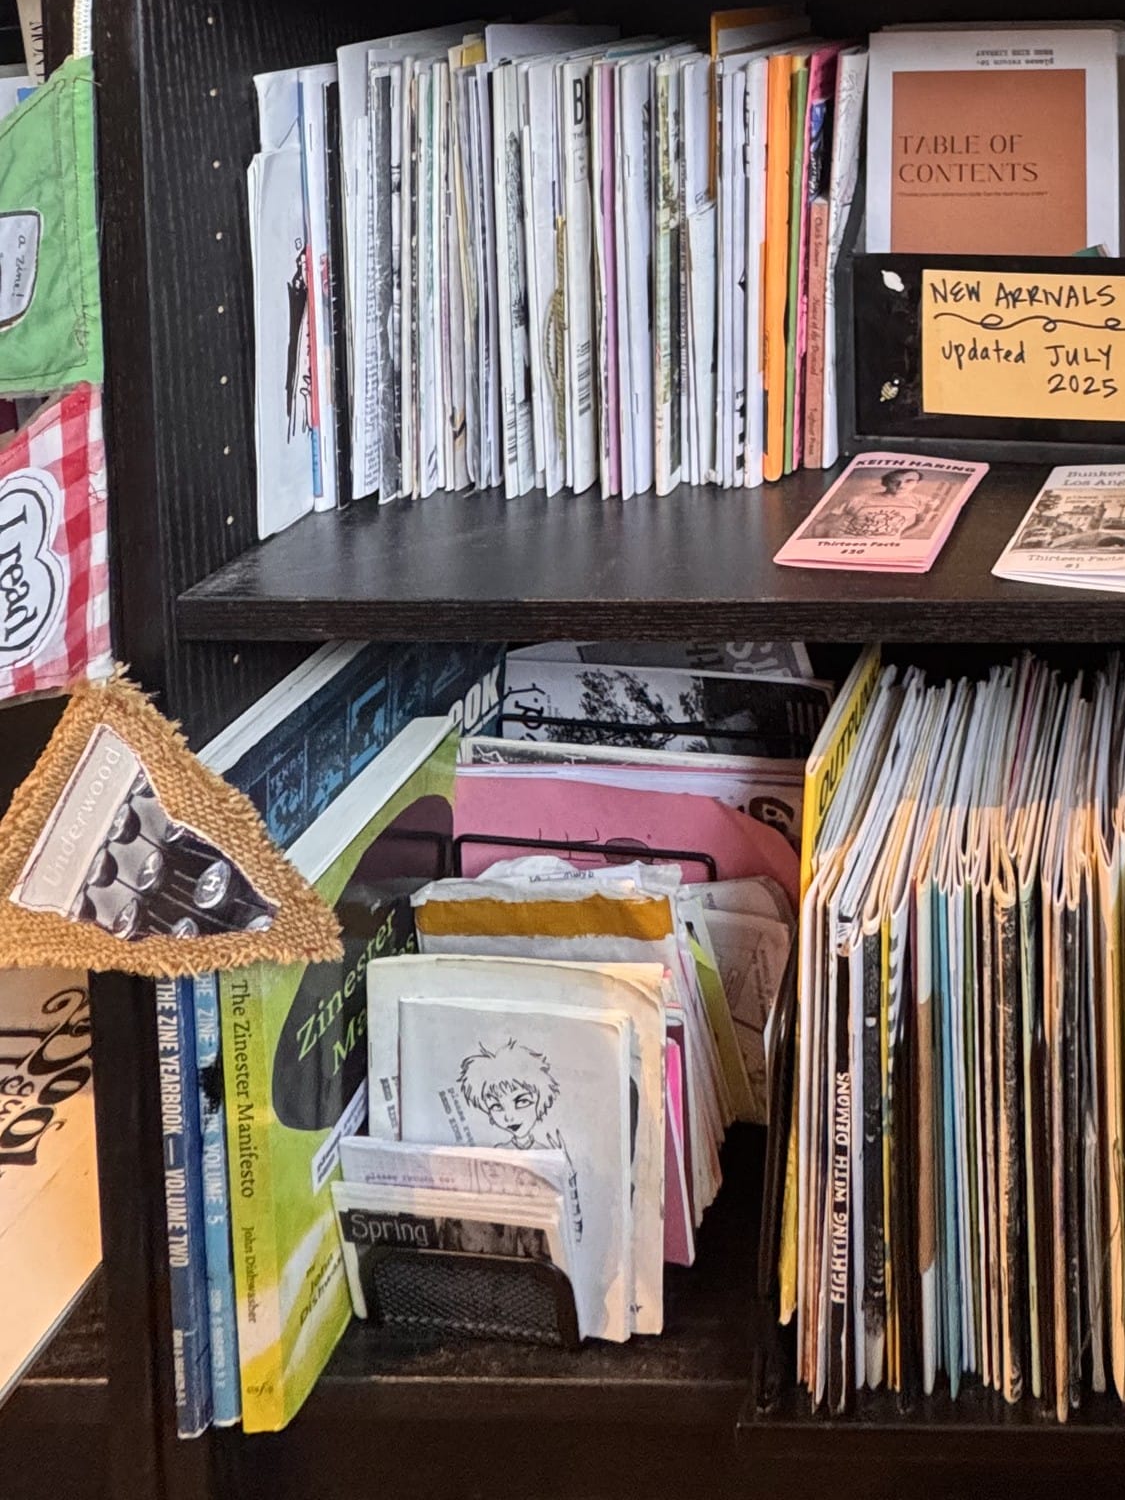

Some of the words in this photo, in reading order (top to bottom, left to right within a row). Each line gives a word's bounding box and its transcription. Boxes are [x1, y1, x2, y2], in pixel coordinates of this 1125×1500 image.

[898, 134, 981, 155] TABLE
[989, 133, 1024, 155] OF
[898, 161, 1040, 183] CONTENTS
[929, 278, 981, 304] NEW
[994, 281, 1116, 309] ARRIVALS
[941, 337, 1026, 370] updated
[1044, 343, 1113, 371] JULY
[1047, 373, 1119, 399] 2025
[855, 458, 905, 467] KEITH
[908, 460, 977, 473] HARING
[1062, 478, 1091, 487] Los
[817, 540, 868, 548] Thirteen
[1028, 553, 1085, 562] Thirteen
[1087, 554, 1125, 562] Facts
[0, 541, 38, 642] read
[450, 664, 500, 734] OOK
[43, 745, 122, 889] Underwood
[155, 980, 177, 1008] THE
[230, 979, 249, 1017] The
[296, 908, 396, 1063] Zinester
[157, 1009, 179, 1045] ZINE
[199, 1005, 217, 1045] ZINE
[231, 1019, 250, 1099] Zinester
[158, 1045, 183, 1136] YEARBOOK
[835, 1071, 852, 1147] DEMONS
[234, 1100, 257, 1199] Manifesto
[201, 1142, 224, 1205] VOLUME
[834, 1154, 849, 1203] WITH
[165, 1168, 188, 1235] VOLUME
[206, 1213, 223, 1226] 5
[242, 1225, 255, 1253] John
[349, 1213, 430, 1246] Spring
[168, 1235, 188, 1269] TWO
[830, 1211, 848, 1305] FIGHTING
[244, 1254, 258, 1325] Dishwasher
